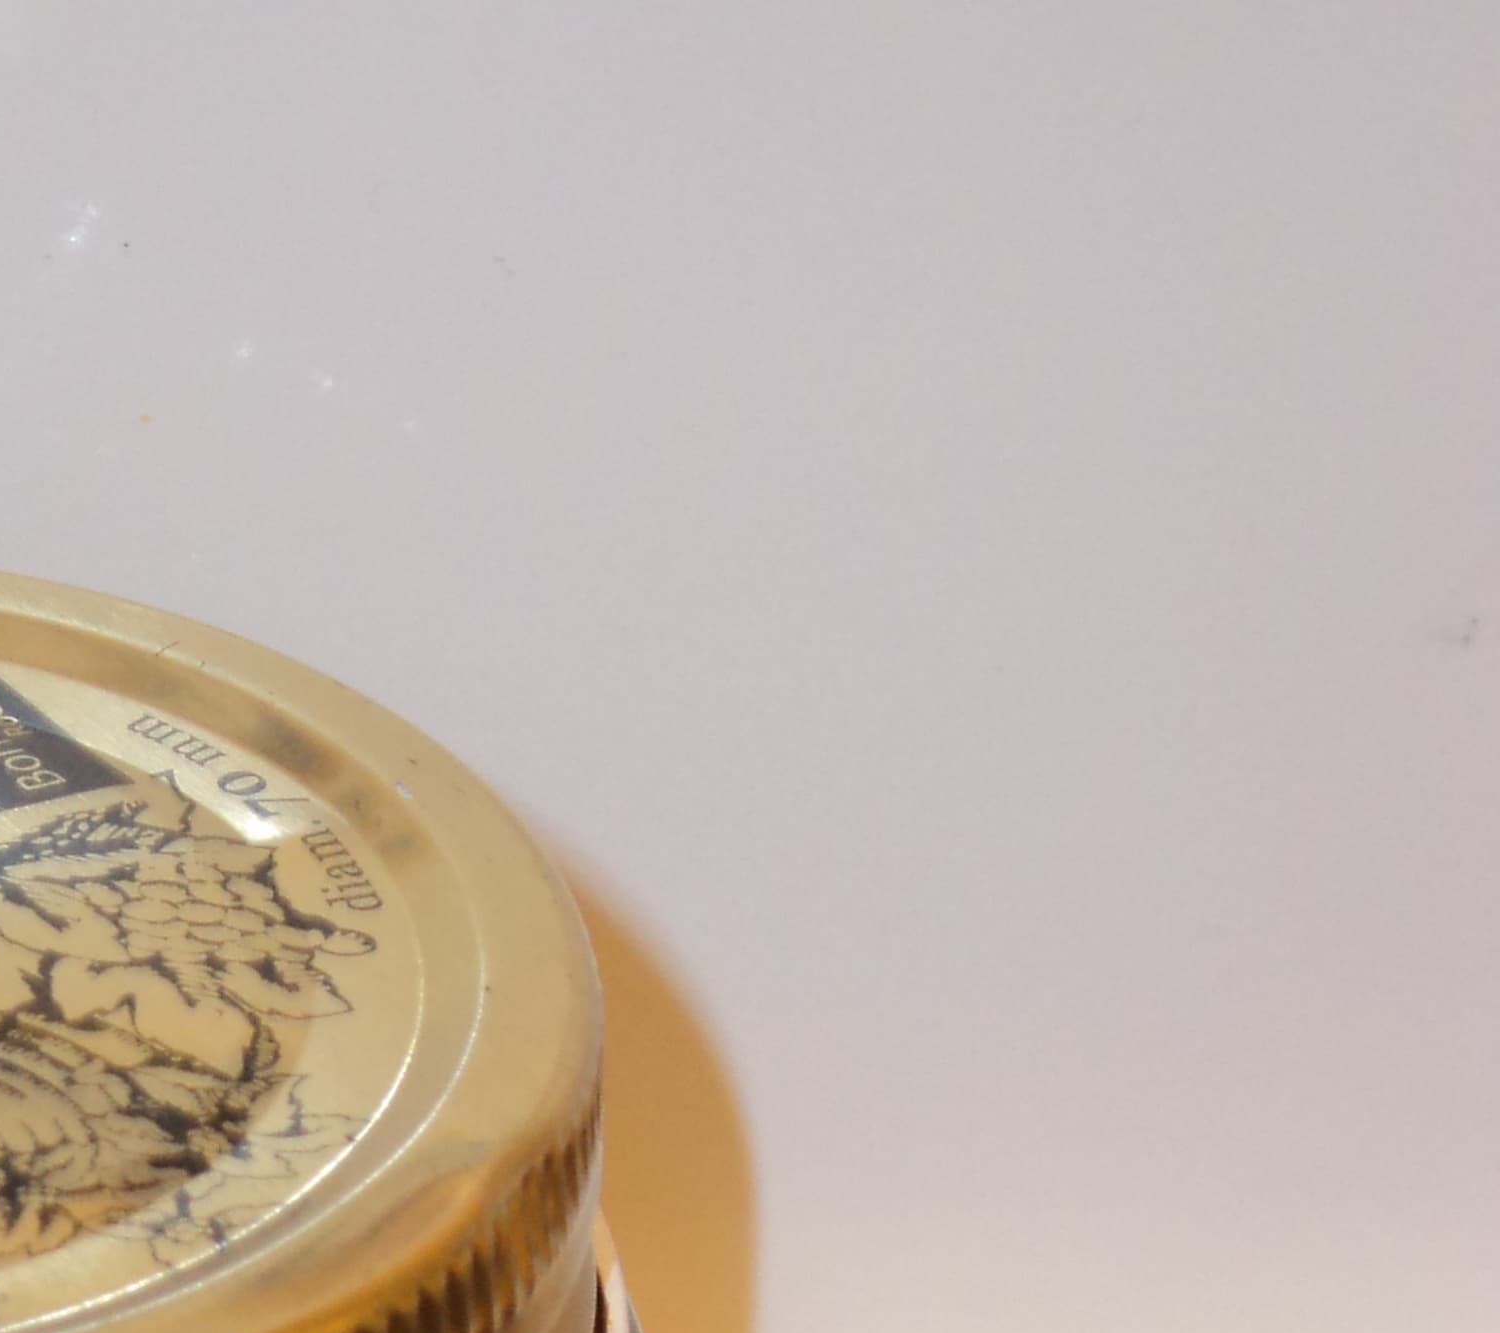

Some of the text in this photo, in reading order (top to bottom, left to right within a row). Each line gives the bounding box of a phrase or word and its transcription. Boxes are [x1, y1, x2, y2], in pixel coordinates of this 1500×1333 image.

[126, 714, 384, 912] diam. 70 mm
